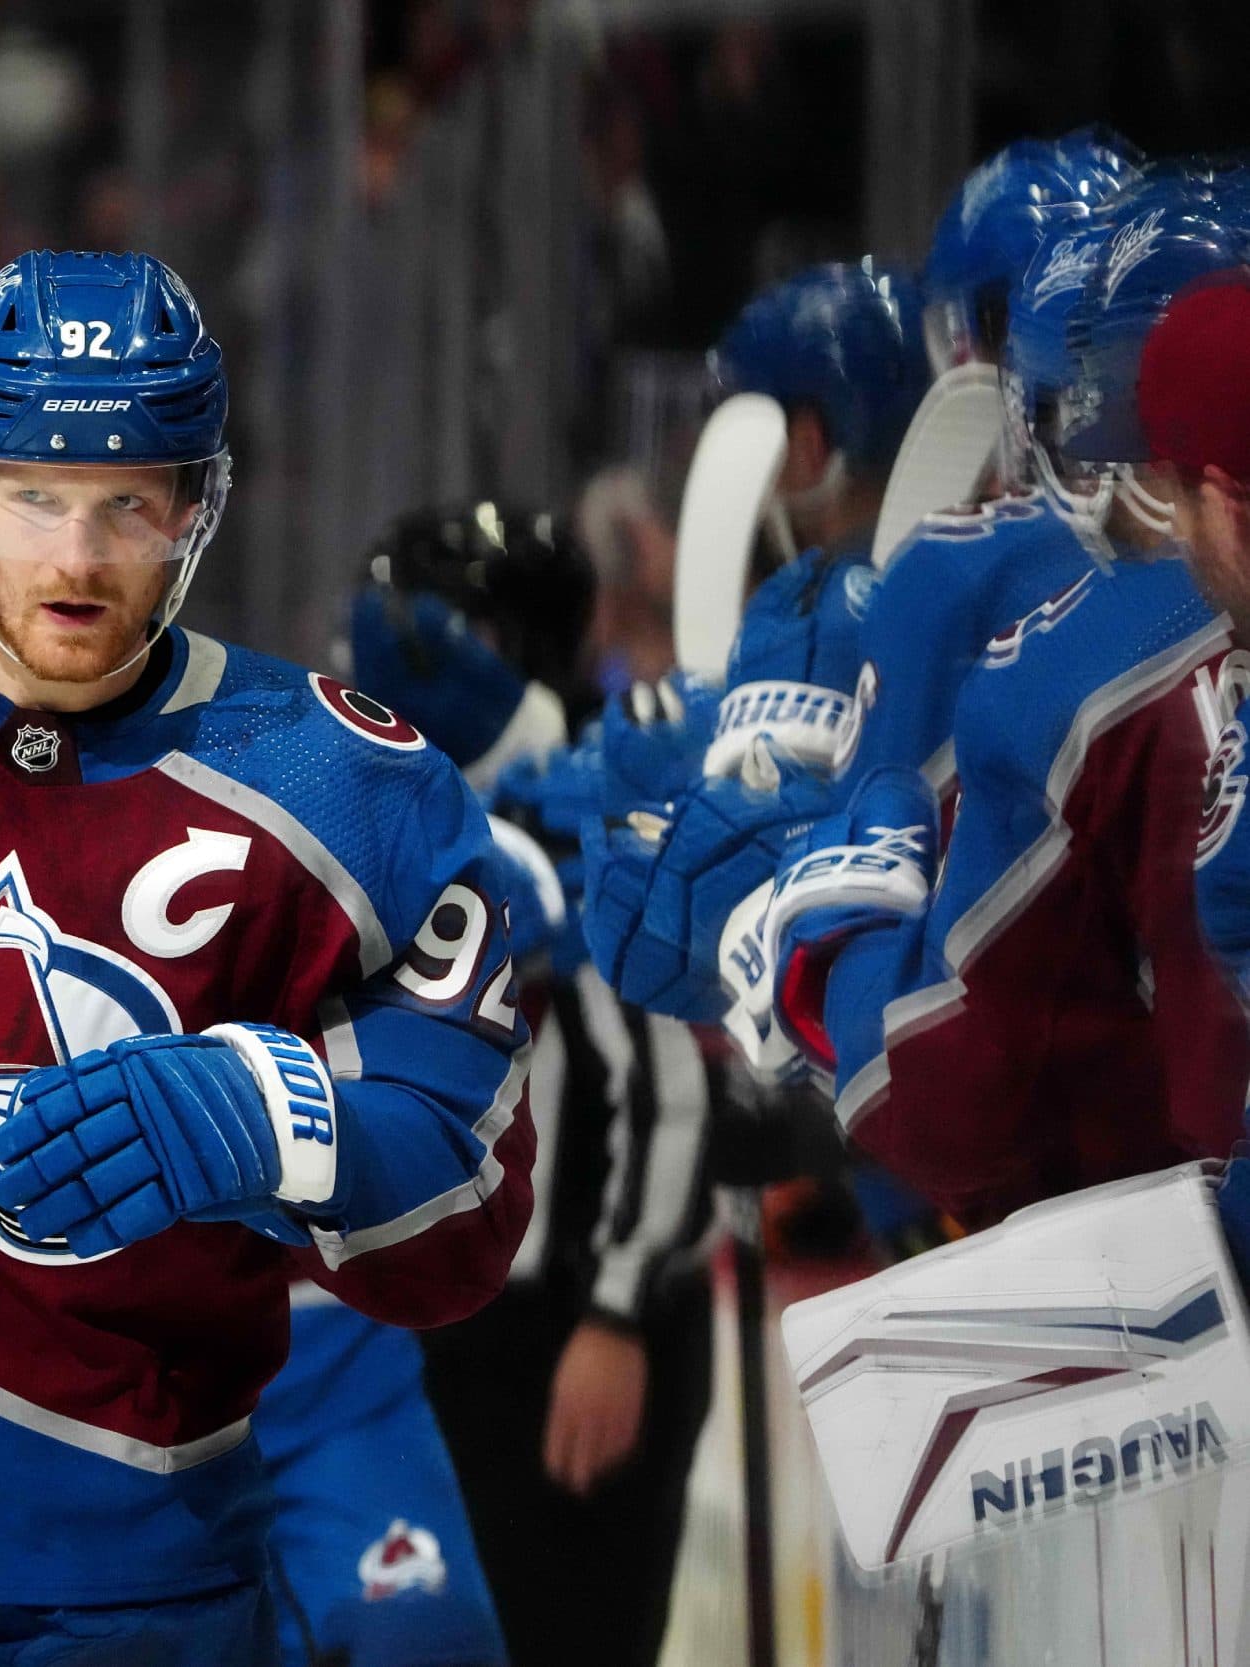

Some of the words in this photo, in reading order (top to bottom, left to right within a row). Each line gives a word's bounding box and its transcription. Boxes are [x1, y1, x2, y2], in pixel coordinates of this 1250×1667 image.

[60, 321, 112, 358] 92
[42, 399, 132, 412] BAUER
[21, 741, 51, 759] NHL
[121, 826, 252, 959] C
[971, 1400, 1232, 1535] VAUGHN
